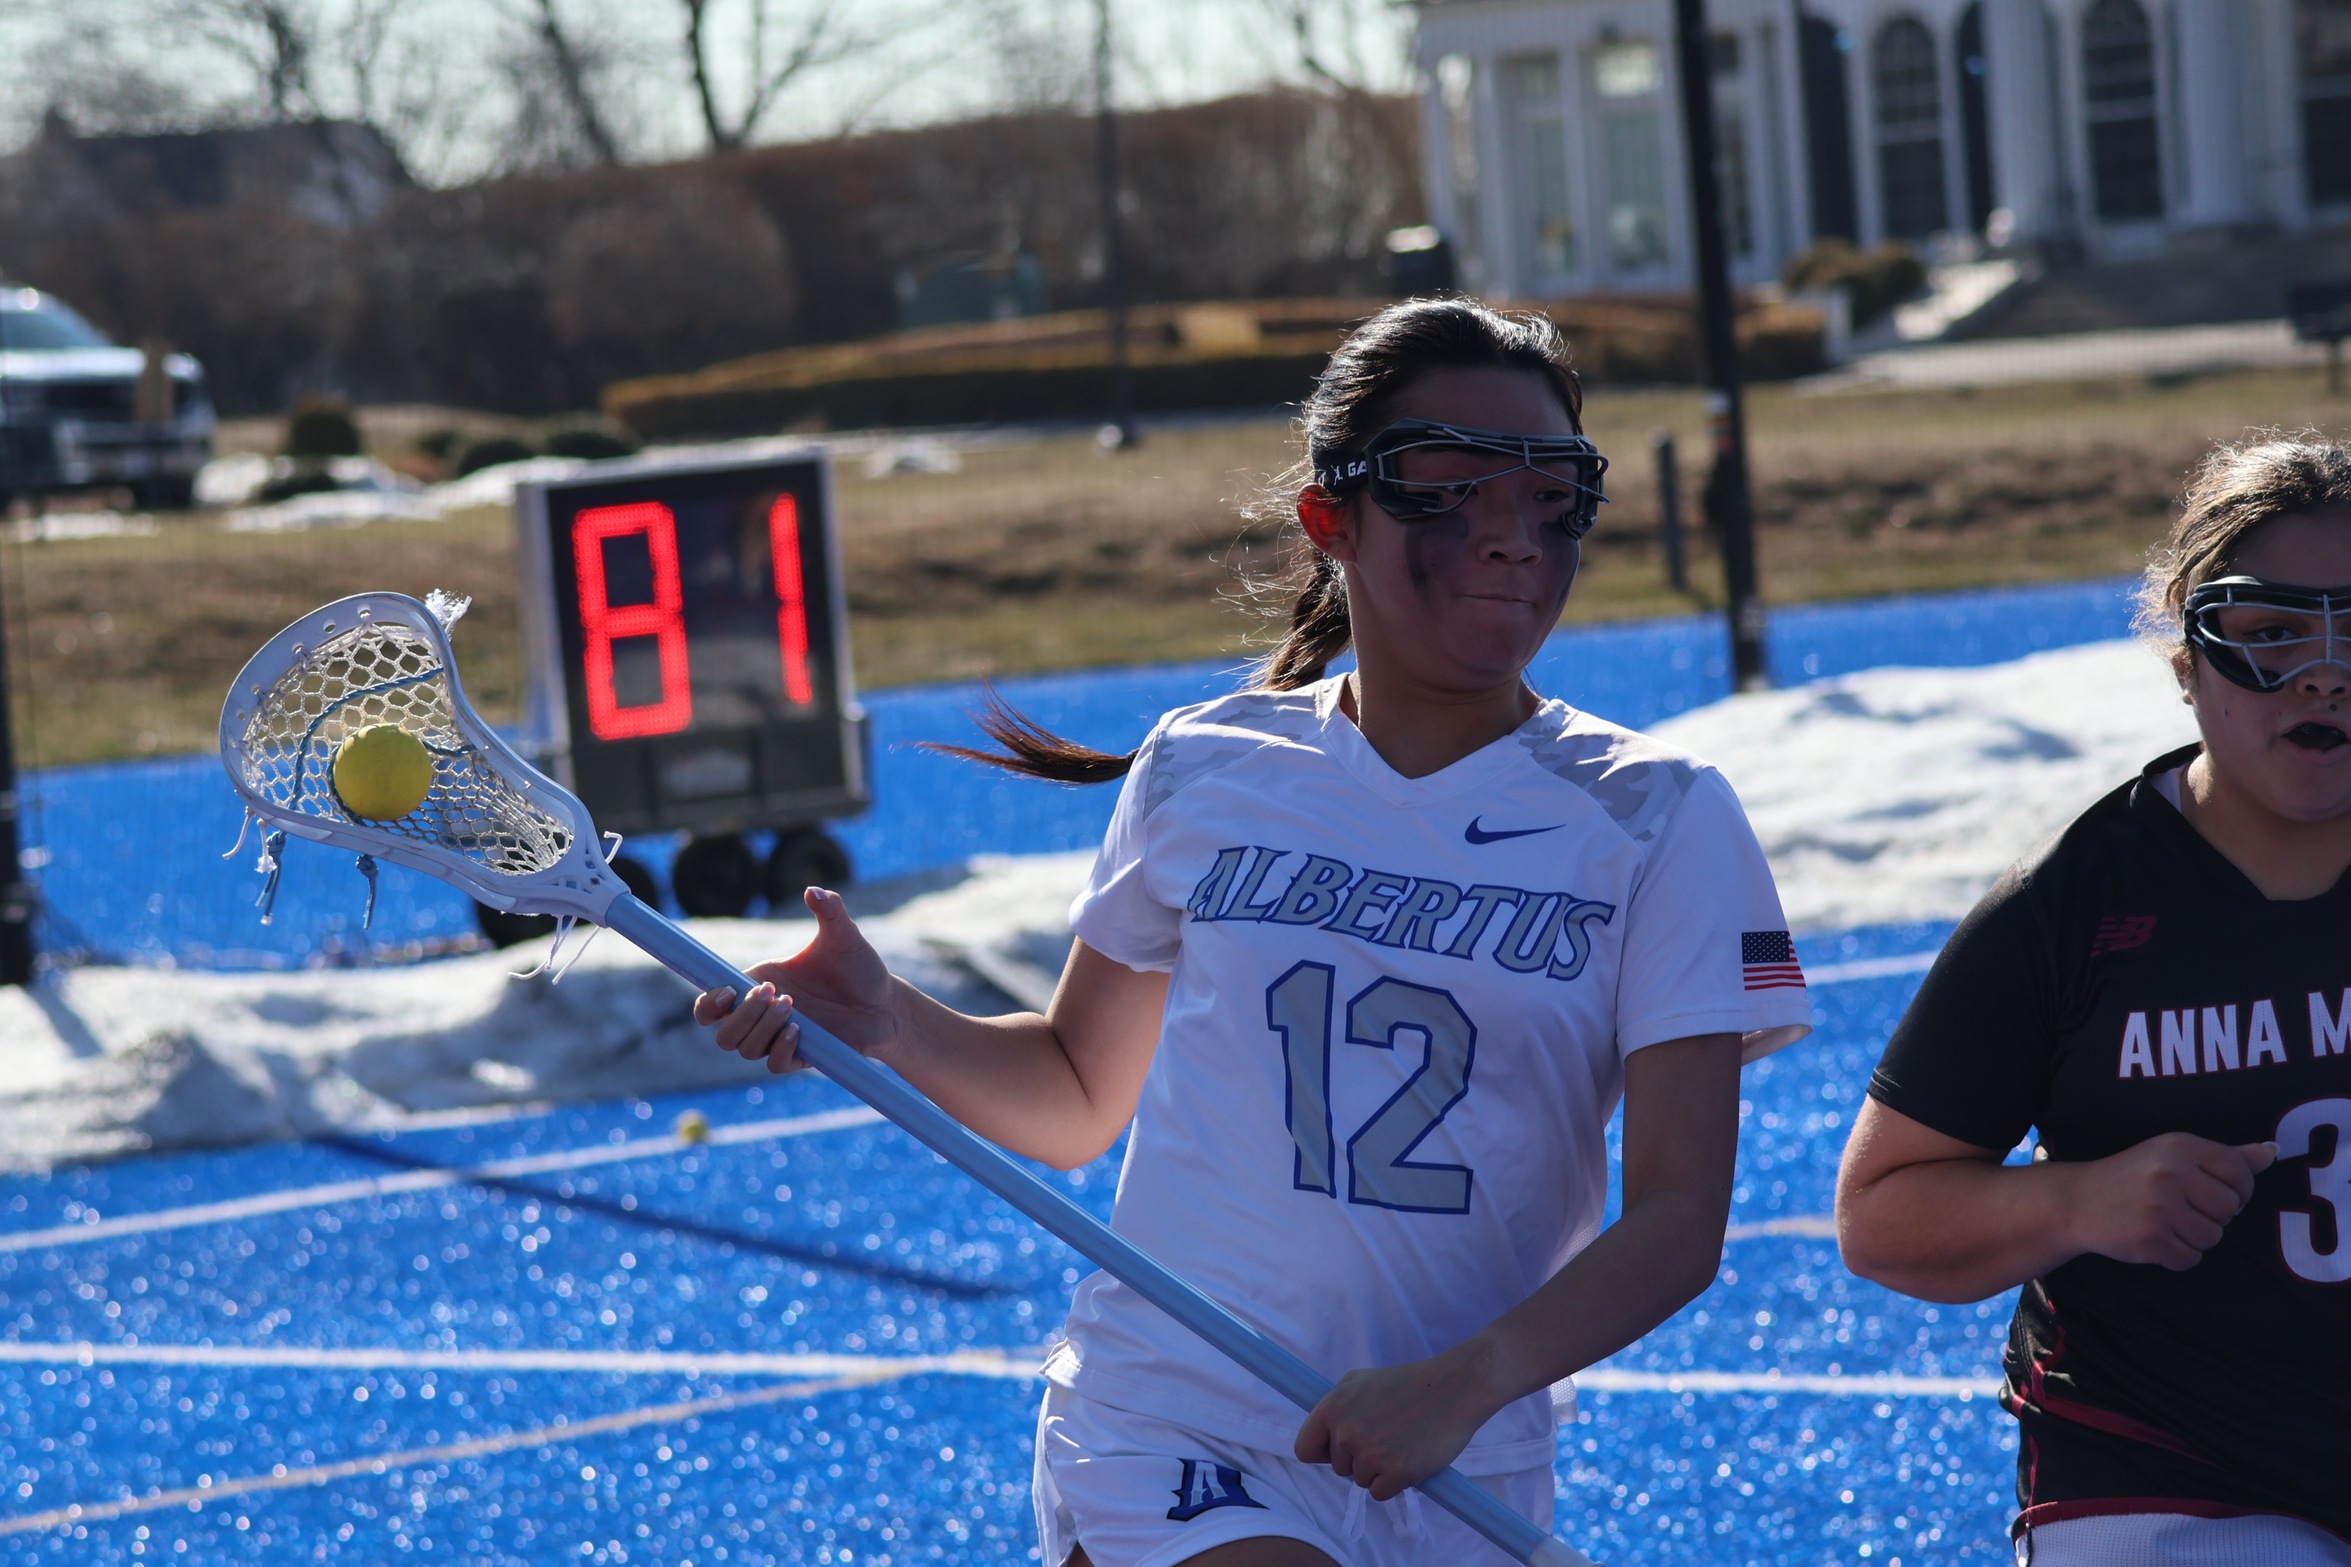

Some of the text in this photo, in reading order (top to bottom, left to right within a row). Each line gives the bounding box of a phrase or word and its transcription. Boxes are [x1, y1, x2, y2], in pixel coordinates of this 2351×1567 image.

[571, 492, 813, 741] 81
[1187, 845, 1616, 982] ALBERTUS
[1265, 959, 1478, 1215] 12
[2117, 998, 2289, 1079] ANNA
[2273, 1096, 2351, 1285] 3
